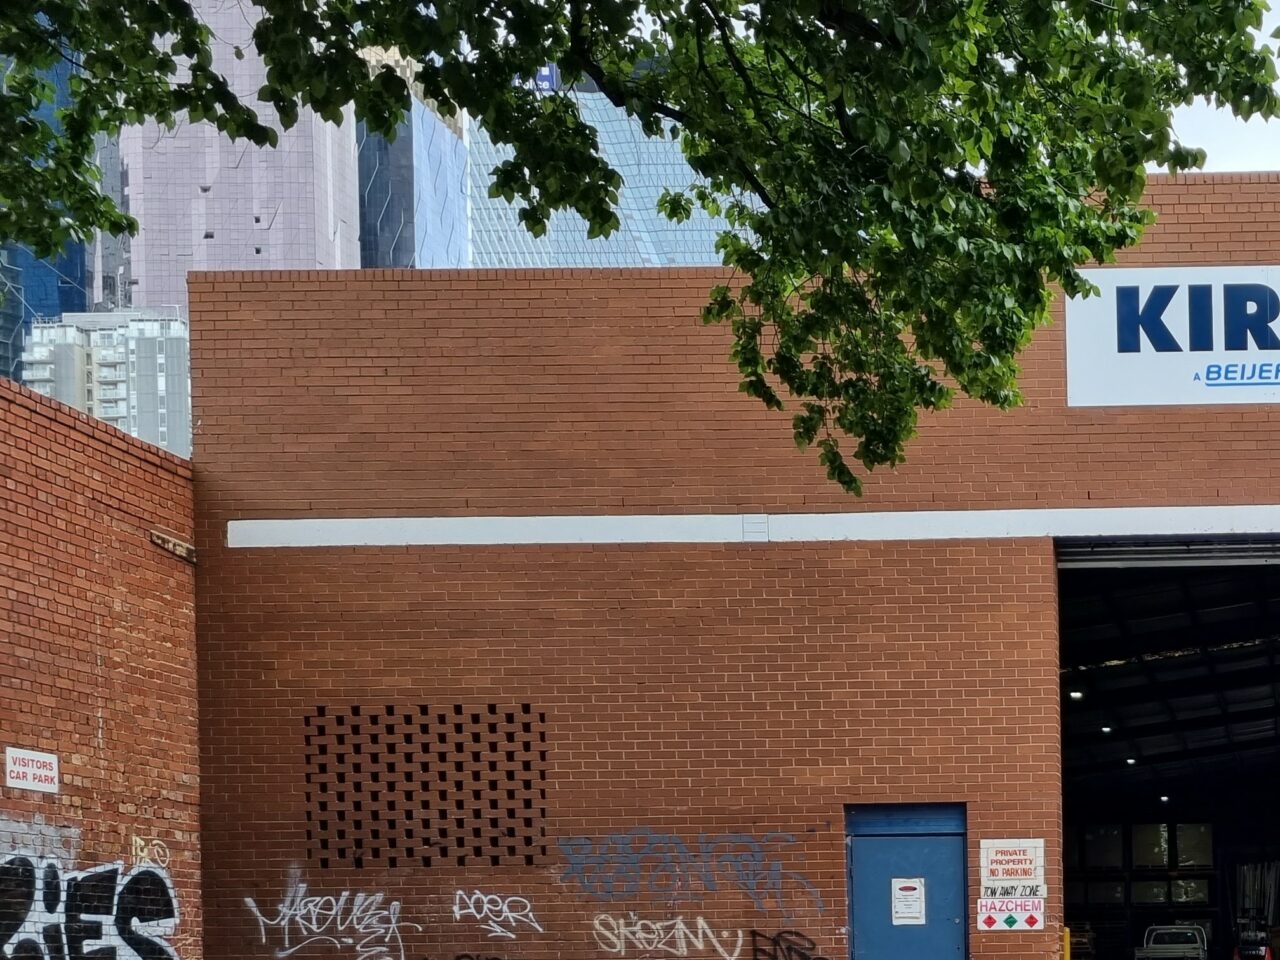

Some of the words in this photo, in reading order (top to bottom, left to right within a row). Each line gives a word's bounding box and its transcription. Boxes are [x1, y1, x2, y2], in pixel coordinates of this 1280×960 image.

[515, 77, 550, 89] Polce
[1193, 373, 1200, 381] A
[12, 756, 54, 771] VISITORS
[9, 770, 28, 781] CAR
[32, 773, 56, 785] PARK
[995, 849, 1027, 857] PRIVATE
[991, 858, 1033, 866] PROPERTY
[990, 868, 999, 877] NO
[983, 886, 999, 898] TOW
[999, 885, 1018, 897] AWAY
[980, 899, 1042, 912] HAZCHEM
